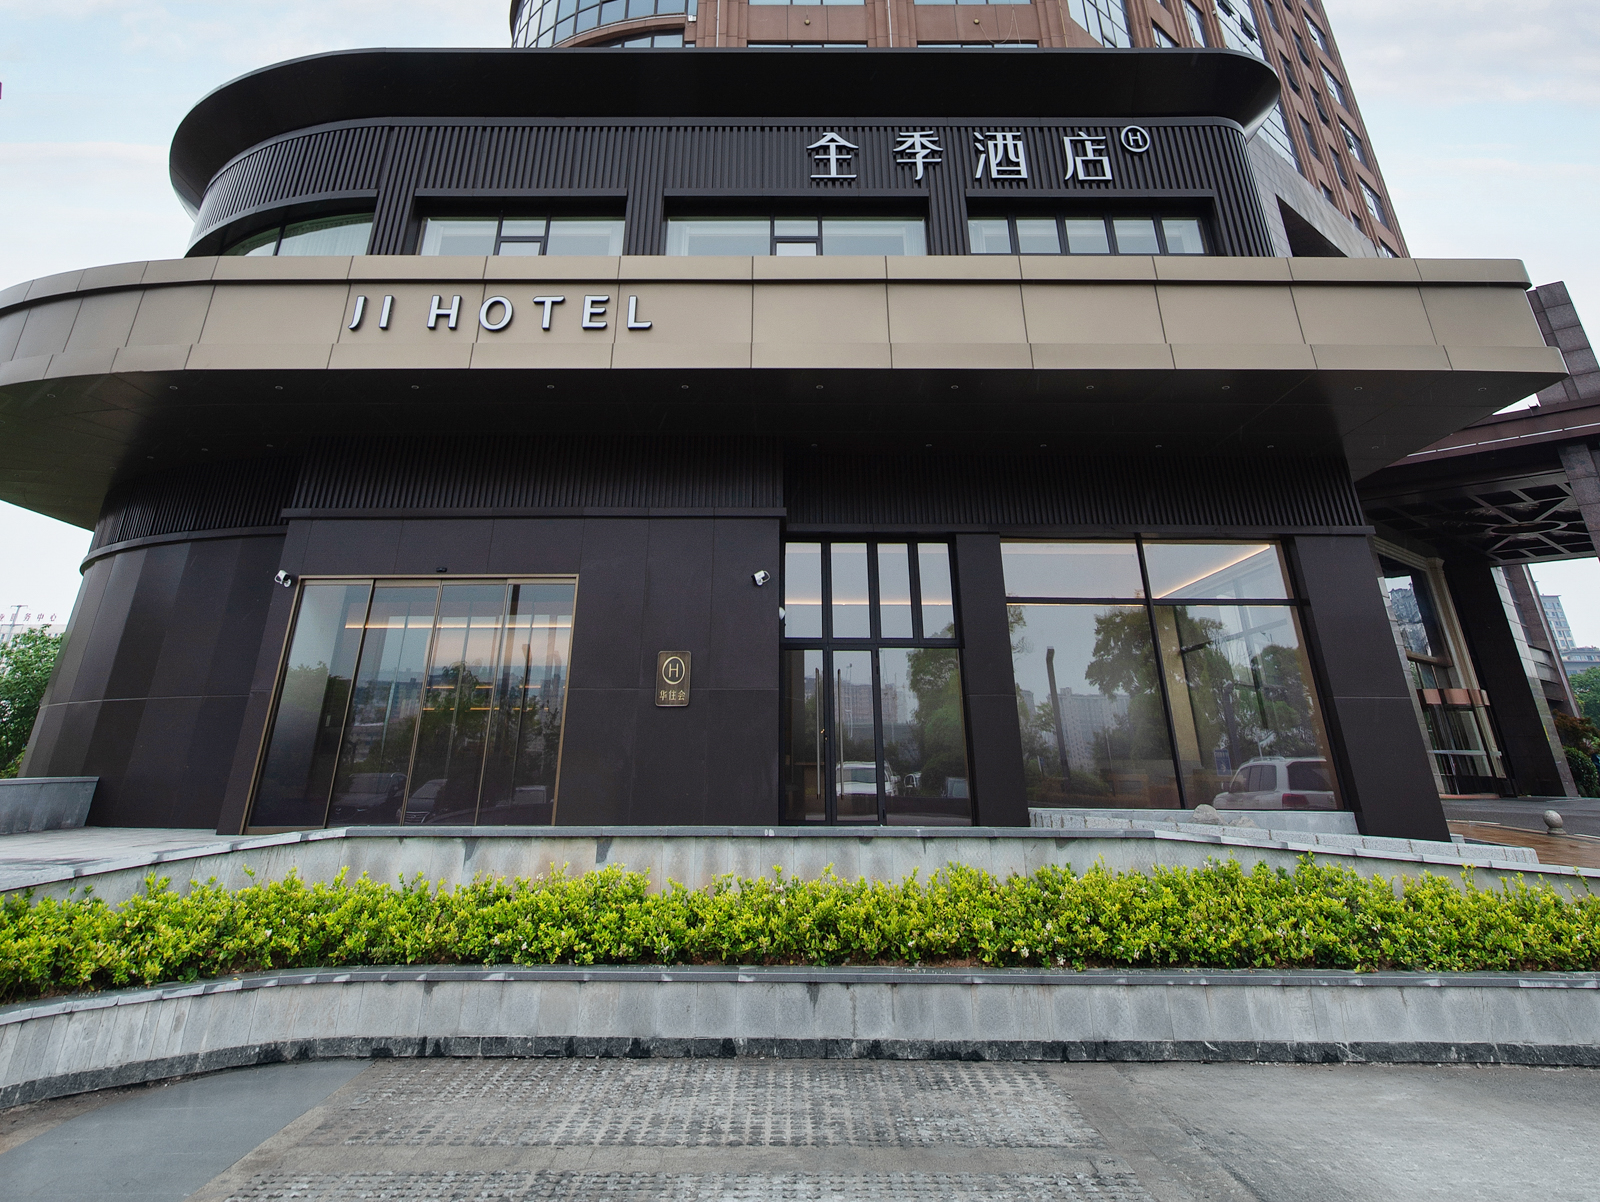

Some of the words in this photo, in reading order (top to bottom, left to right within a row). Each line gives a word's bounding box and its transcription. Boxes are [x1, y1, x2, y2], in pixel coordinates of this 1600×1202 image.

[806, 130, 1113, 181] 全季酒店
[348, 294, 395, 330] JI
[427, 294, 653, 331] HOTEL
[659, 689, 686, 701] 华住会
